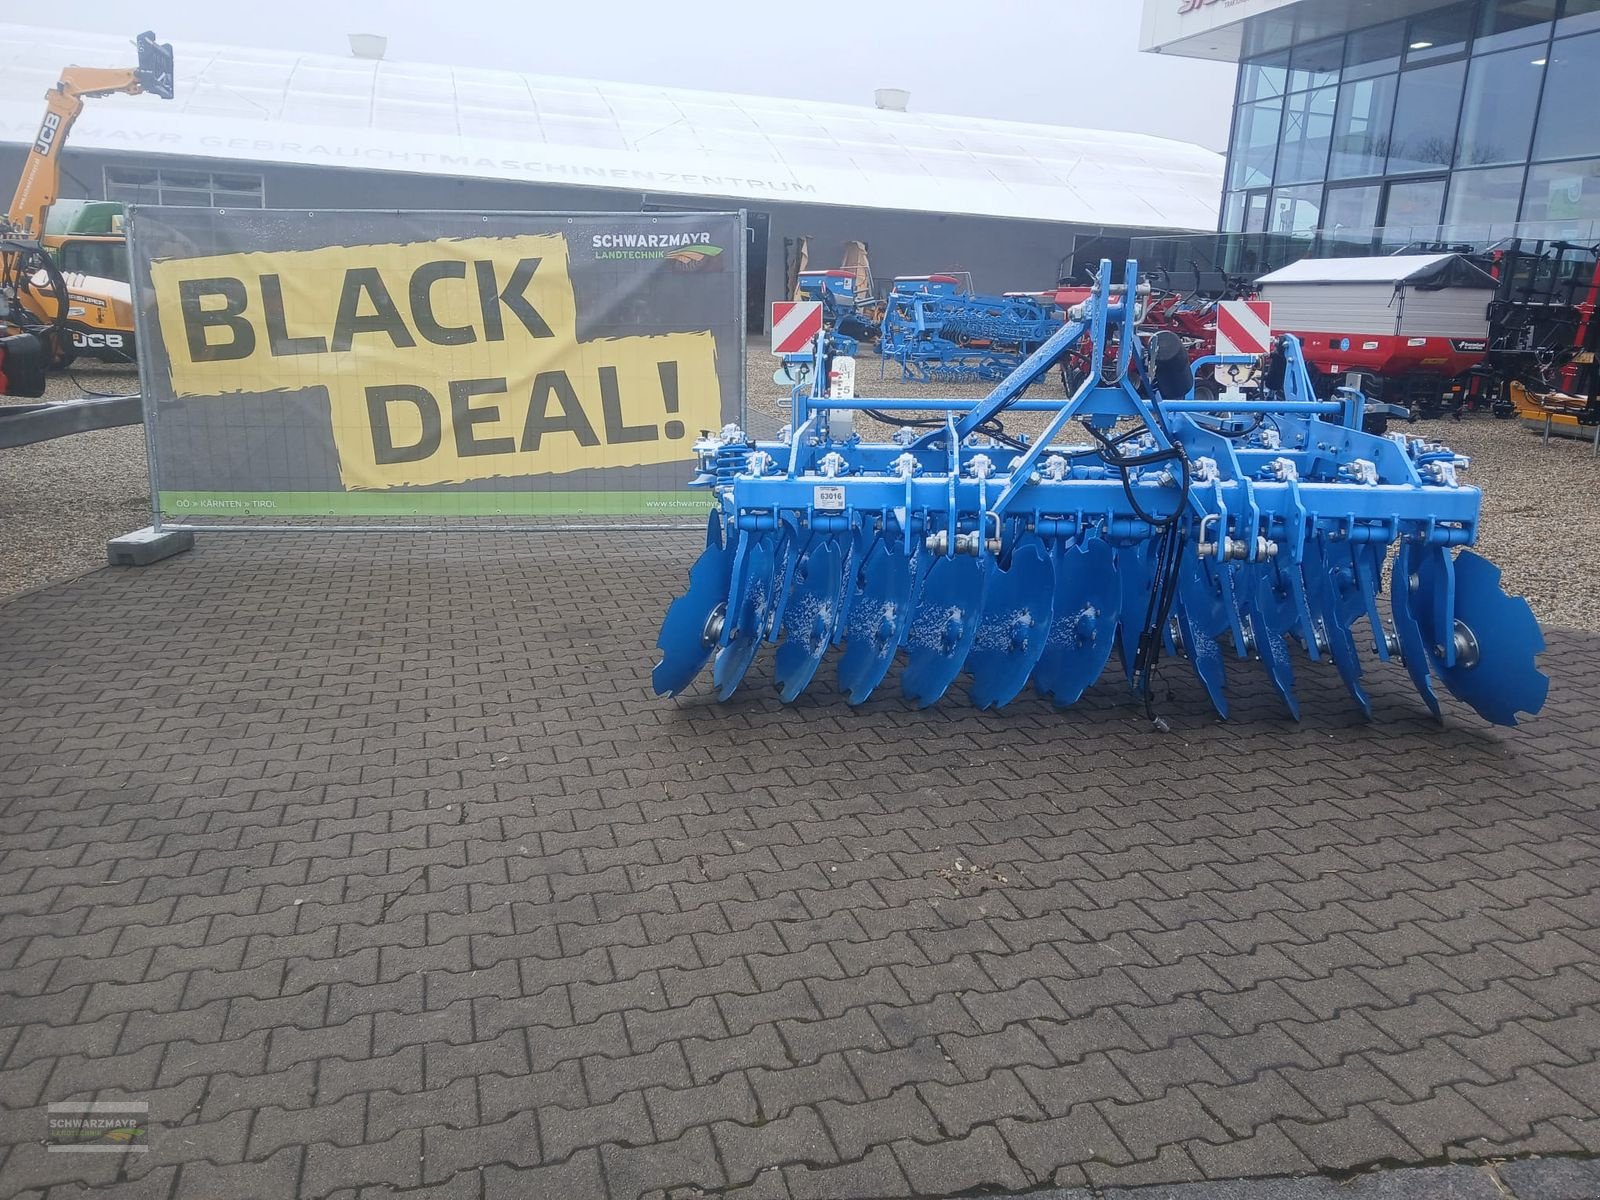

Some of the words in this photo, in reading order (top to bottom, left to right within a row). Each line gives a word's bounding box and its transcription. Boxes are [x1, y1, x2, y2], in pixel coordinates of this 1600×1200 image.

[38, 112, 60, 155] JCB
[592, 232, 711, 248] SCHWARZMAYR
[595, 250, 665, 260] LANDTECHNIK
[178, 256, 556, 363] BLACK
[73, 333, 123, 348] JCB
[364, 360, 686, 466] DEAL!
[820, 492, 842, 500] 63016
[252, 500, 277, 508] TIROL
